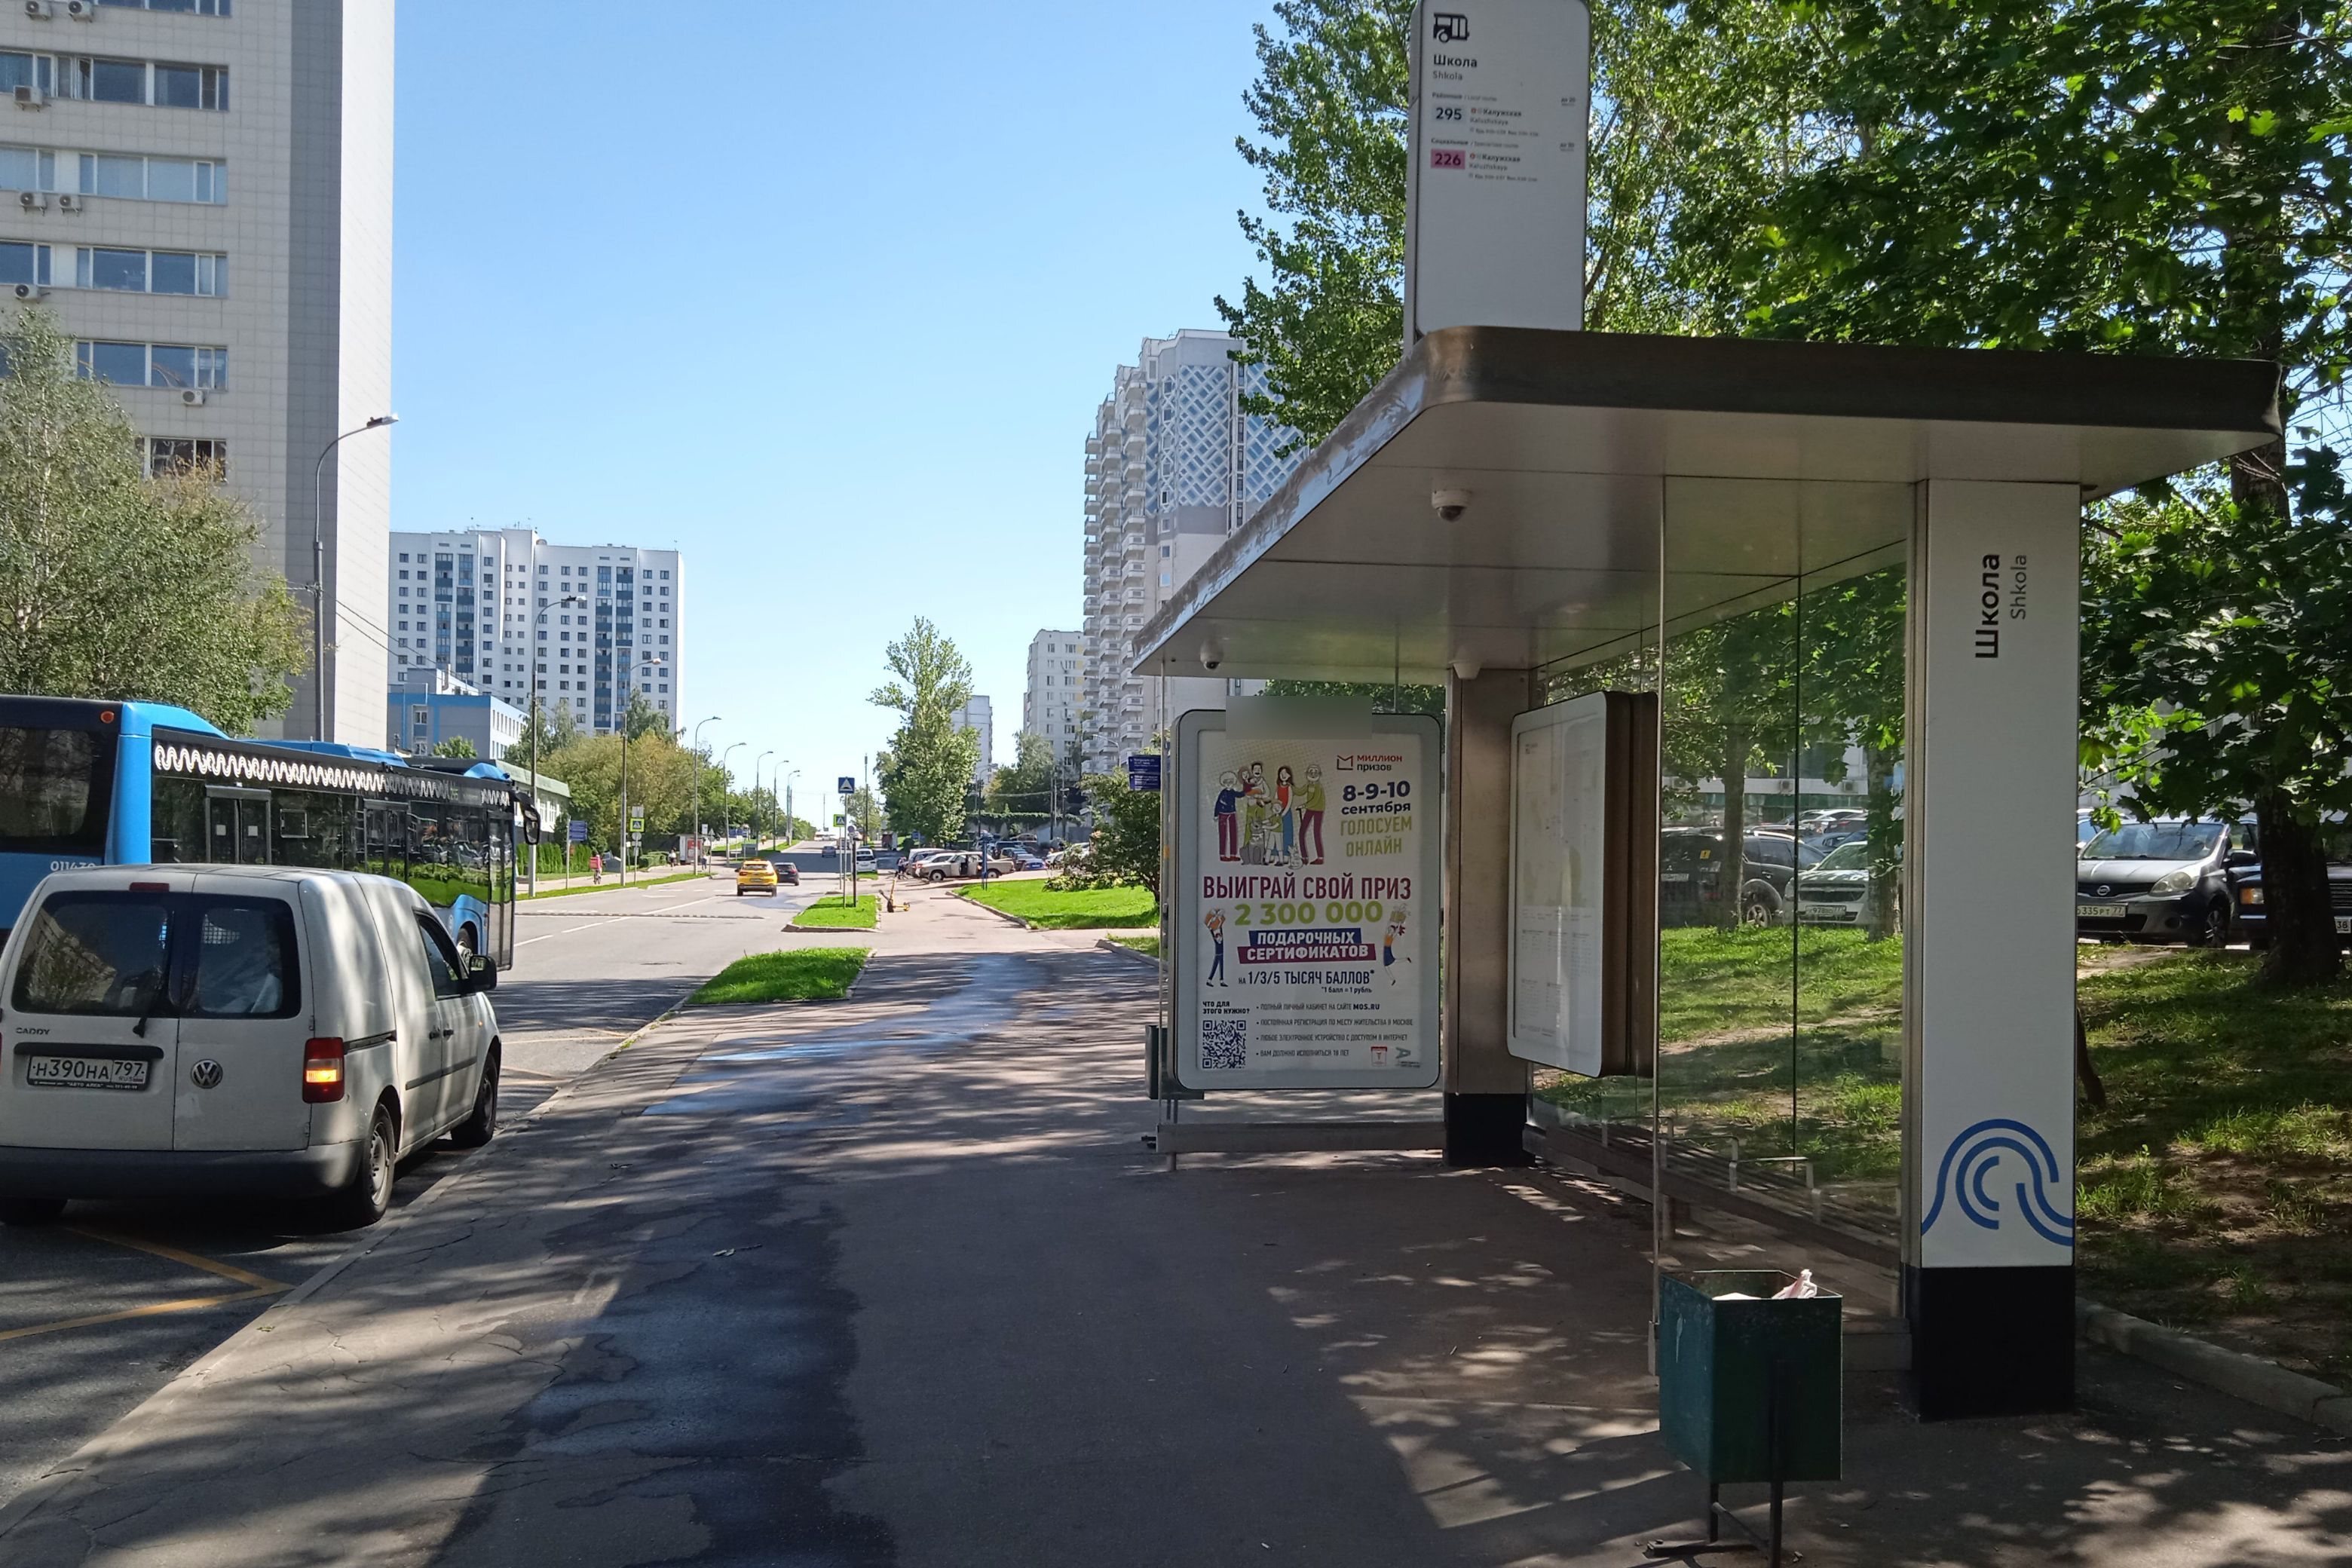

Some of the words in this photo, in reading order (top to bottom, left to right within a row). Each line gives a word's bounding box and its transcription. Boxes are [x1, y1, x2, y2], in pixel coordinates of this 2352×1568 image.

[1433, 54, 1478, 68] Школа
[1433, 71, 1462, 81] Shkola
[1435, 108, 1462, 121] 295
[1435, 153, 1461, 166] 226
[2010, 555, 2026, 620] Shkola
[1975, 554, 2000, 658] Школа
[1343, 780, 1410, 802] 8-9-10
[1341, 801, 1410, 814] сентября
[1340, 815, 1412, 836] ГОЛОСУЕМ
[1346, 835, 1402, 857] ОНЛАЙН
[1203, 871, 1296, 899] ВЫИГРАЙ
[1303, 872, 1352, 899] СВОЙ
[1361, 877, 1411, 899] ПРИЗ
[1234, 904, 1251, 926] 2
[1260, 902, 1315, 926] 300
[1325, 900, 1383, 923] 000
[1257, 932, 1355, 946] ПОДАРОЧНЫХ
[1246, 945, 1369, 961] СЕРТИФИКАТОВ
[1248, 970, 1280, 985] 1/3/5
[1284, 970, 1322, 985] ТЫСЯЧ
[16, 1027, 51, 1036] CADDY
[114, 1061, 142, 1076] 797
